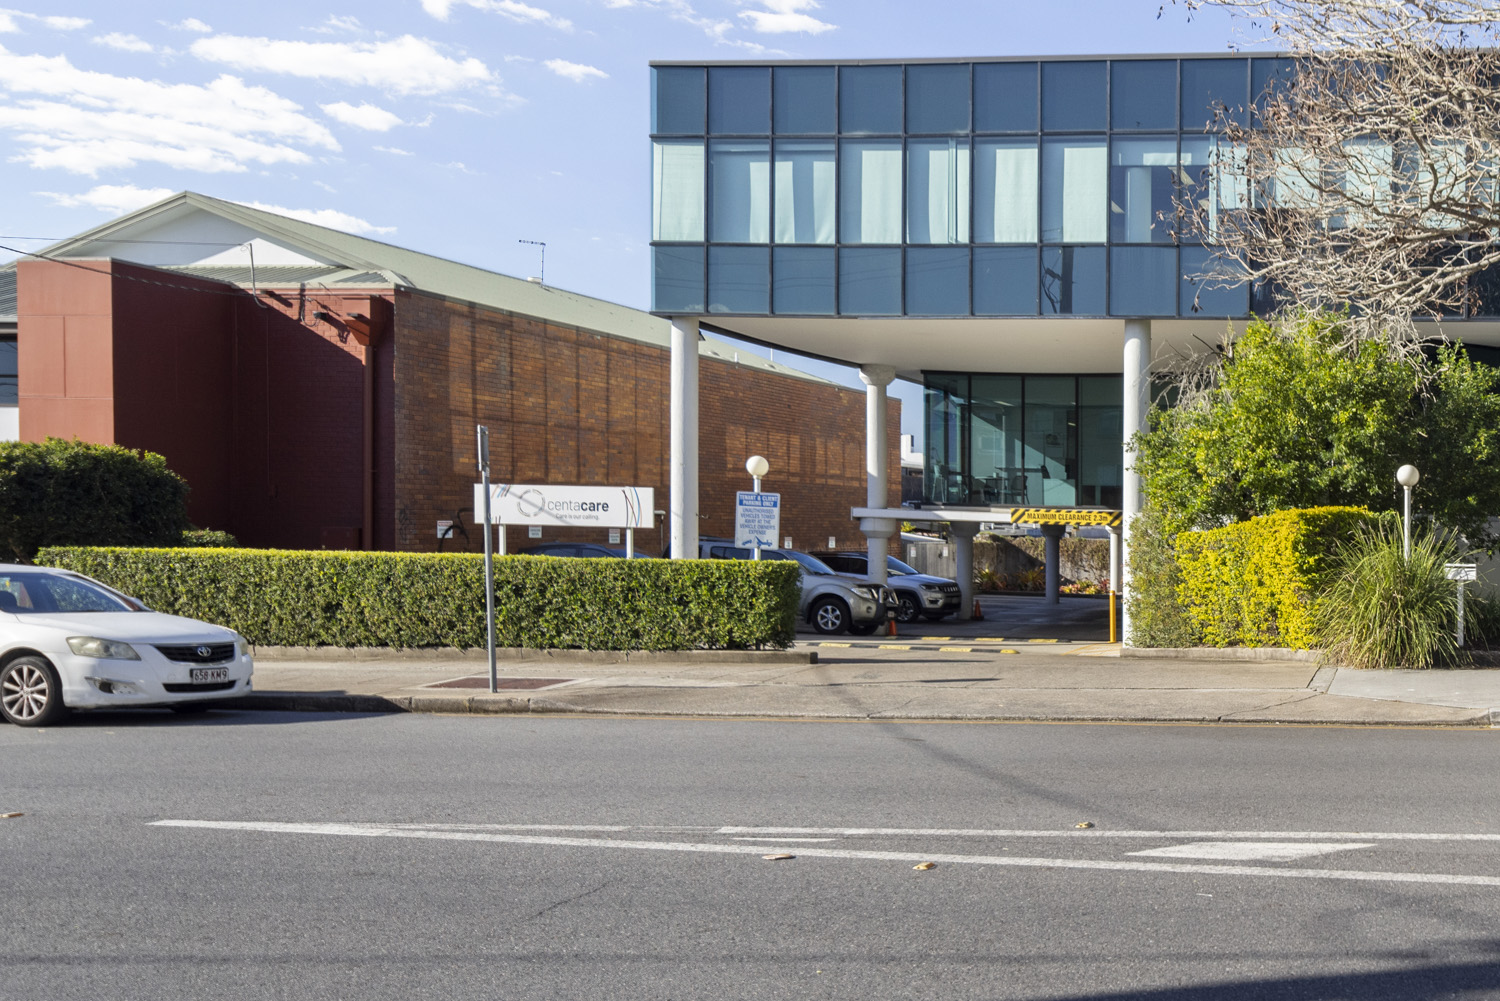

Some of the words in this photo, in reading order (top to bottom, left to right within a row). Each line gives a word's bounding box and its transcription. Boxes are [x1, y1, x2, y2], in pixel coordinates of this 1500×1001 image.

[547, 500, 609, 512] centacare
[1026, 512, 1057, 520] MAXIMUM
[1058, 513, 1091, 521] CLEARANCE
[1093, 514, 1108, 522] 2.3m
